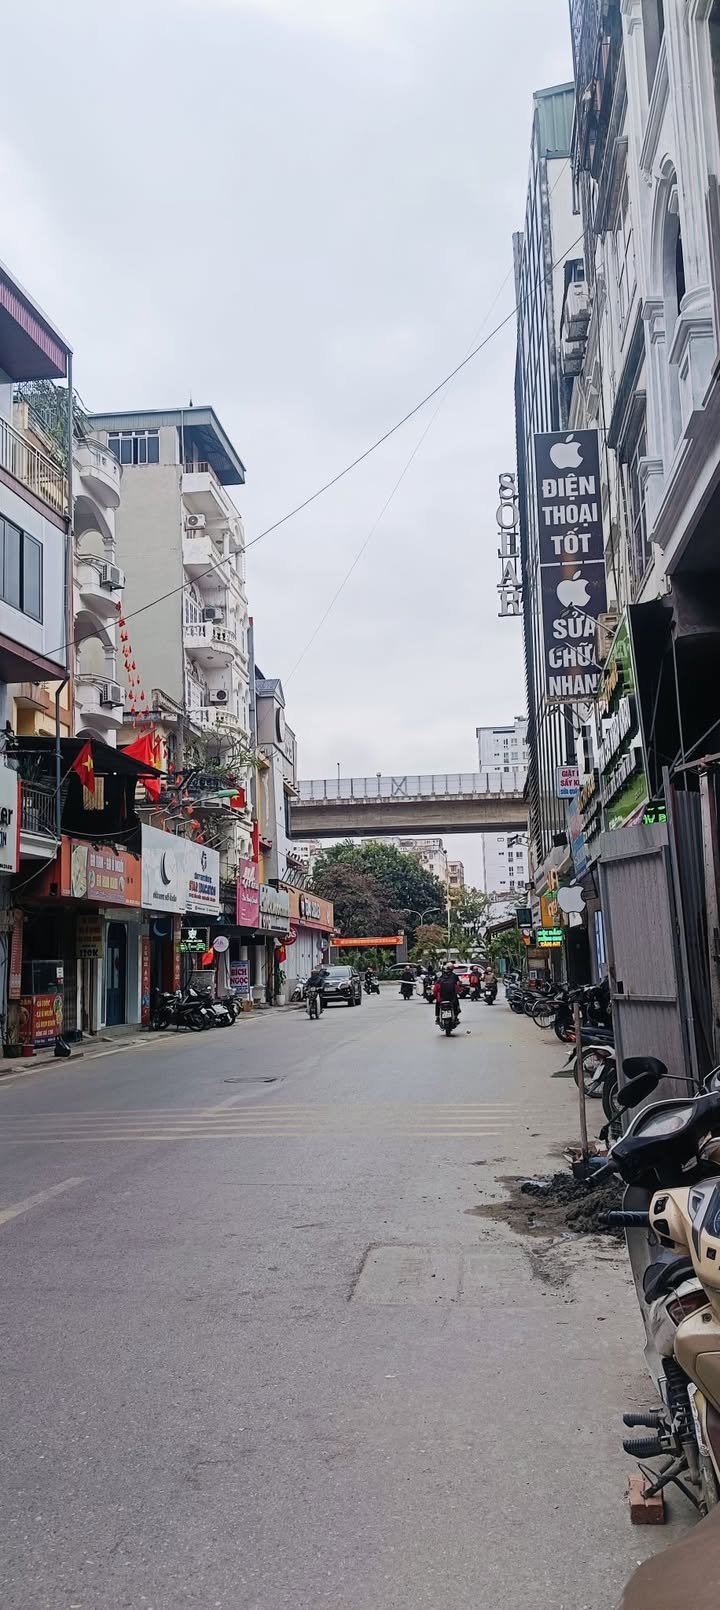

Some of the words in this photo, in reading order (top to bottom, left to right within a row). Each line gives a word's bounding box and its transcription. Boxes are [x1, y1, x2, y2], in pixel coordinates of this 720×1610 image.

[542, 474, 596, 500] ĐIỆN
[542, 504, 598, 527] THOẠI
[496, 472, 523, 617] SOLAR
[551, 527, 592, 554] TỐT
[549, 673, 600, 697] NHAN
[230, 967, 247, 976] BÍCH
[230, 977, 249, 986] NGỌC
